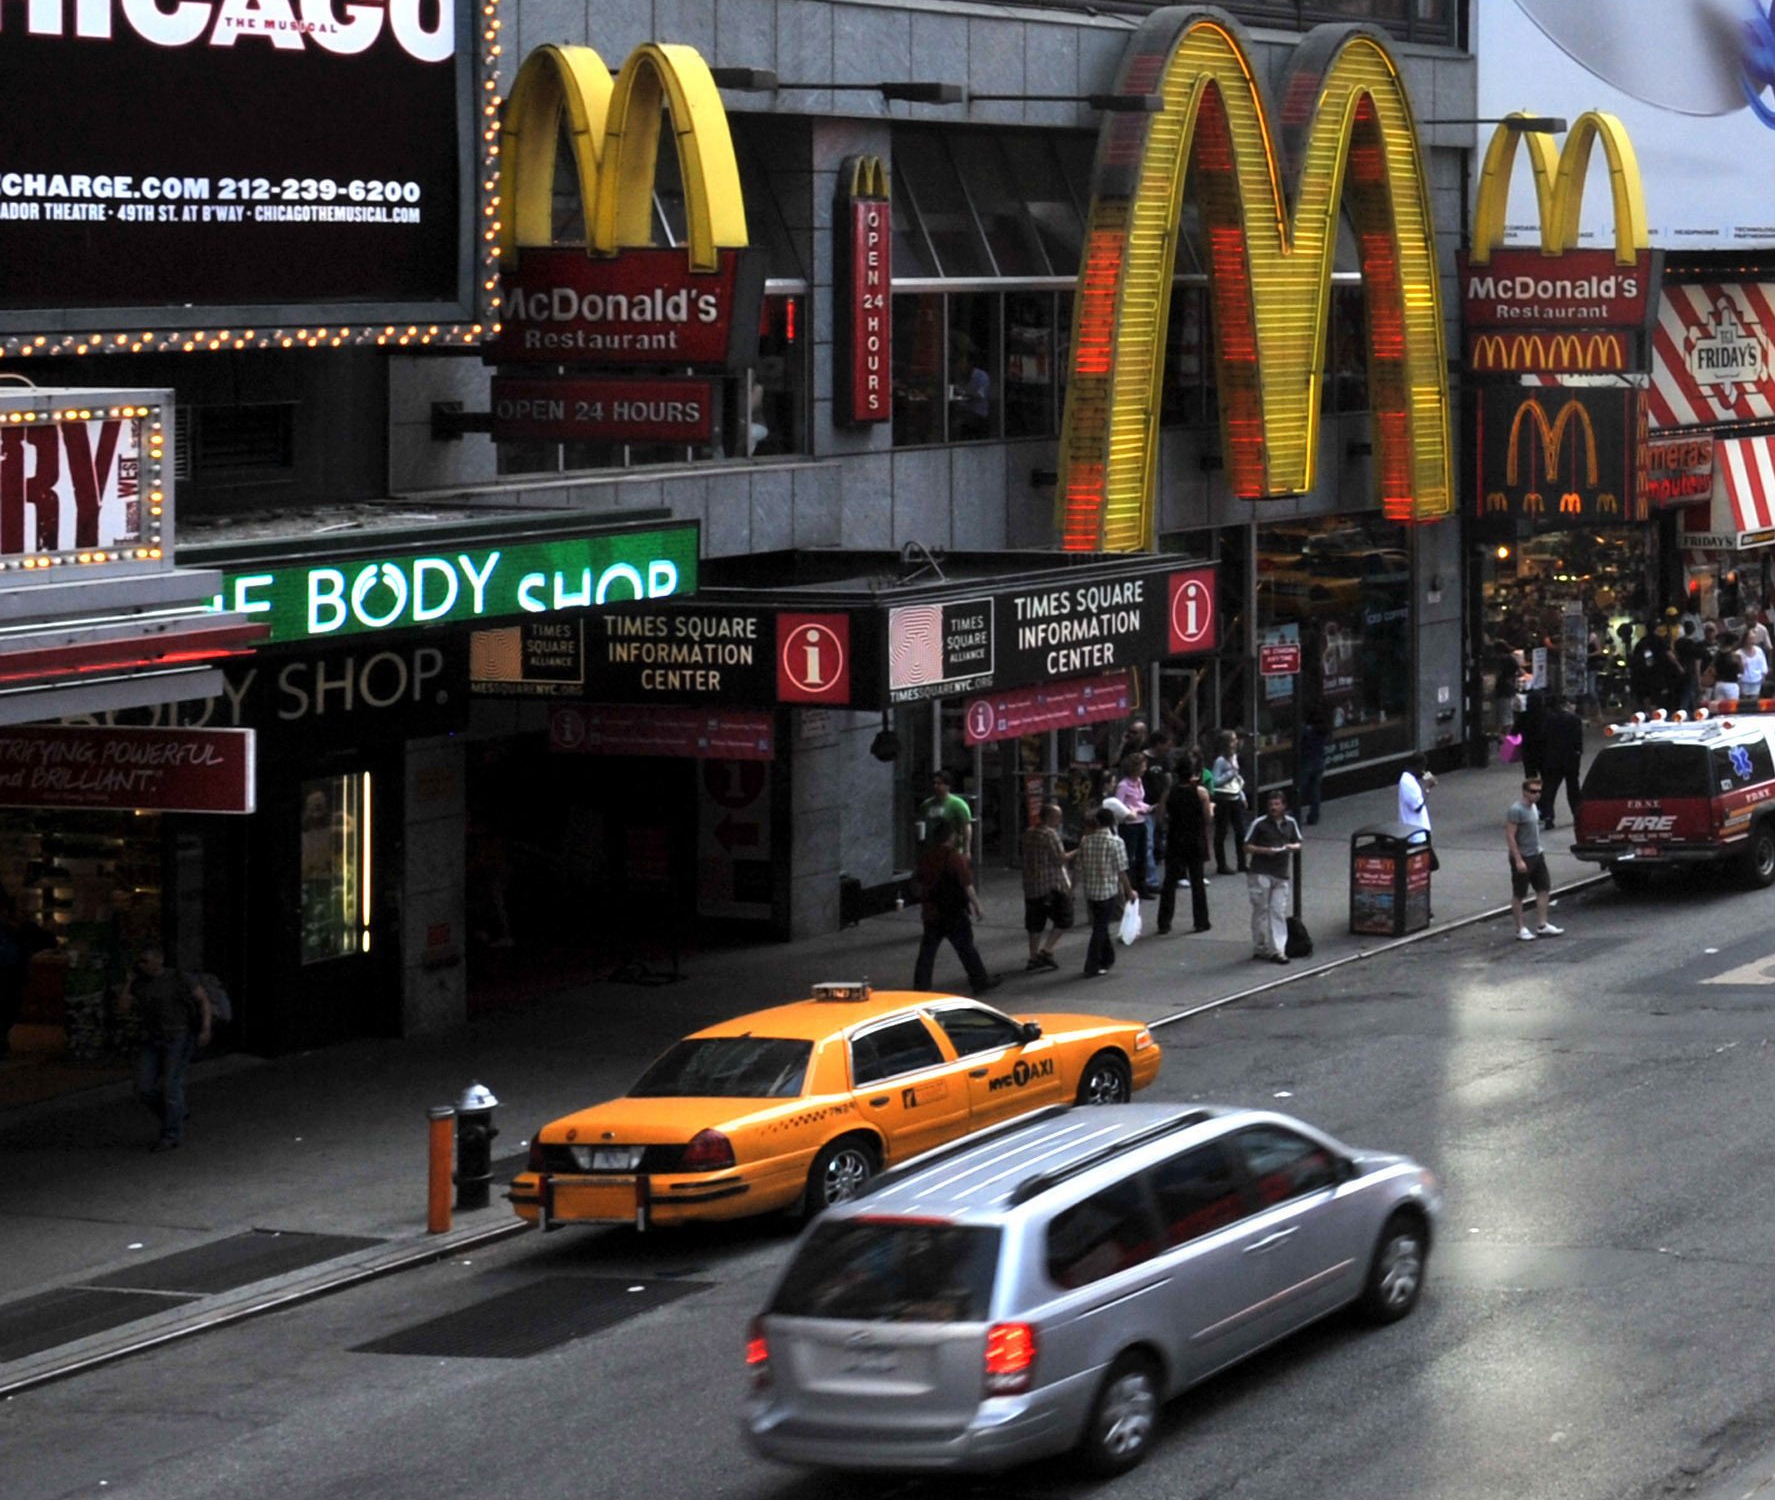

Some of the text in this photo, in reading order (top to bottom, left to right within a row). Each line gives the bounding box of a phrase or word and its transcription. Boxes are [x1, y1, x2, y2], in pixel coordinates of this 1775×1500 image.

[225, 17, 338, 34] THE MUSICAL
[217, 178, 420, 202] 212-239-6200
[44, 203, 420, 224] THEATRE 49TH ST. AT CHICAGOTHEMUSICAL.COM
[1467, 275, 1638, 302] McDonald's
[863, 211, 884, 412] OPEN 24 HOURS
[1496, 303, 1608, 320] Restaurant
[524, 329, 678, 351] Restaurant
[1698, 343, 1757, 370] FRIDAY'S
[573, 402, 700, 423] 24 HOURS
[307, 551, 501, 634] BODY
[517, 558, 680, 612] SHOP
[1014, 580, 1144, 620] TIMES SQUARE
[604, 615, 757, 640] TIMES SQUARE
[951, 615, 984, 631] TIMES
[1018, 609, 1140, 650] INFORMATION
[947, 632, 988, 650] SQUARE
[608, 643, 753, 665] INFORMATION
[1047, 642, 1114, 674] CENTER
[641, 670, 720, 691] CENTER
[890, 676, 993, 702] TIMESSQUARENYC.ORG
[1616, 815, 1678, 831] FIRE
[989, 1075, 1013, 1092] NYC
